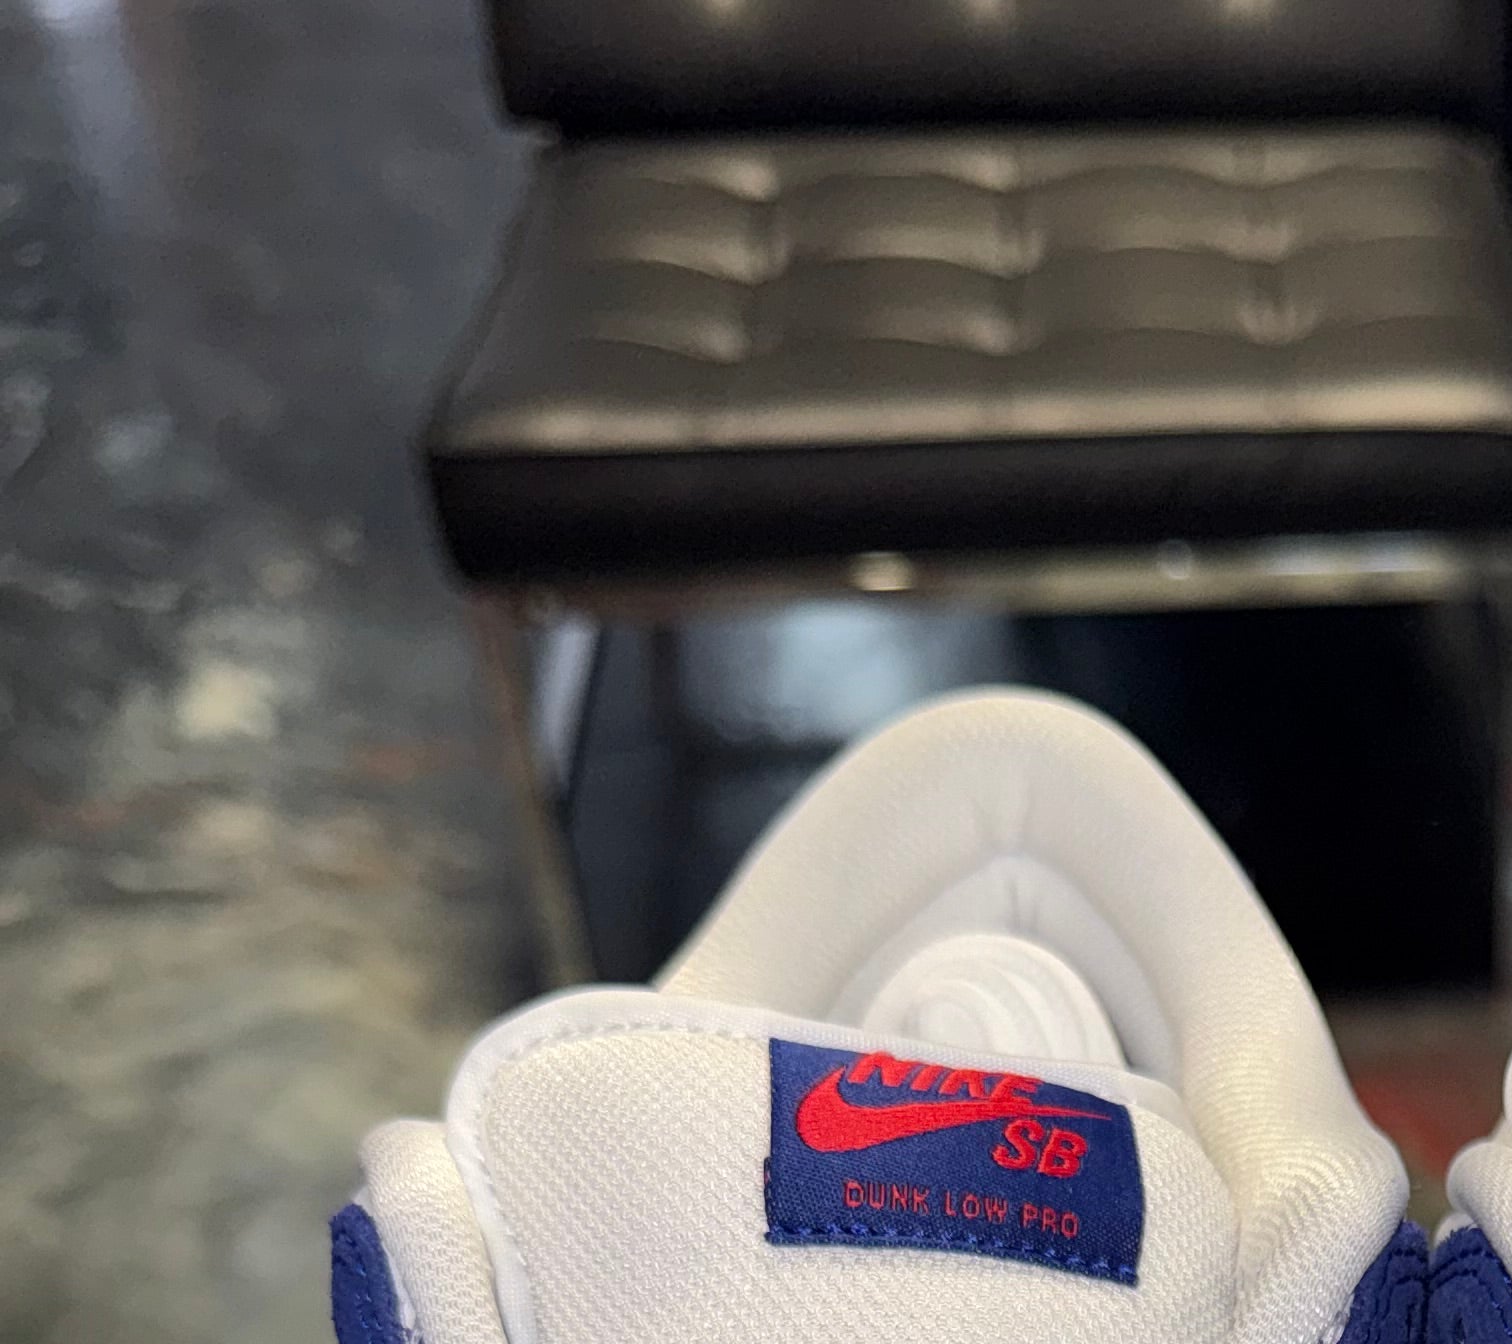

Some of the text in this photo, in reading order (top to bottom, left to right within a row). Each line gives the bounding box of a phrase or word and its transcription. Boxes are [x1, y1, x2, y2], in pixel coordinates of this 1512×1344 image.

[848, 1052, 1044, 1105] NIKE
[991, 1119, 1088, 1178] SB
[844, 1180, 1081, 1239] DUNK LOW PRO
